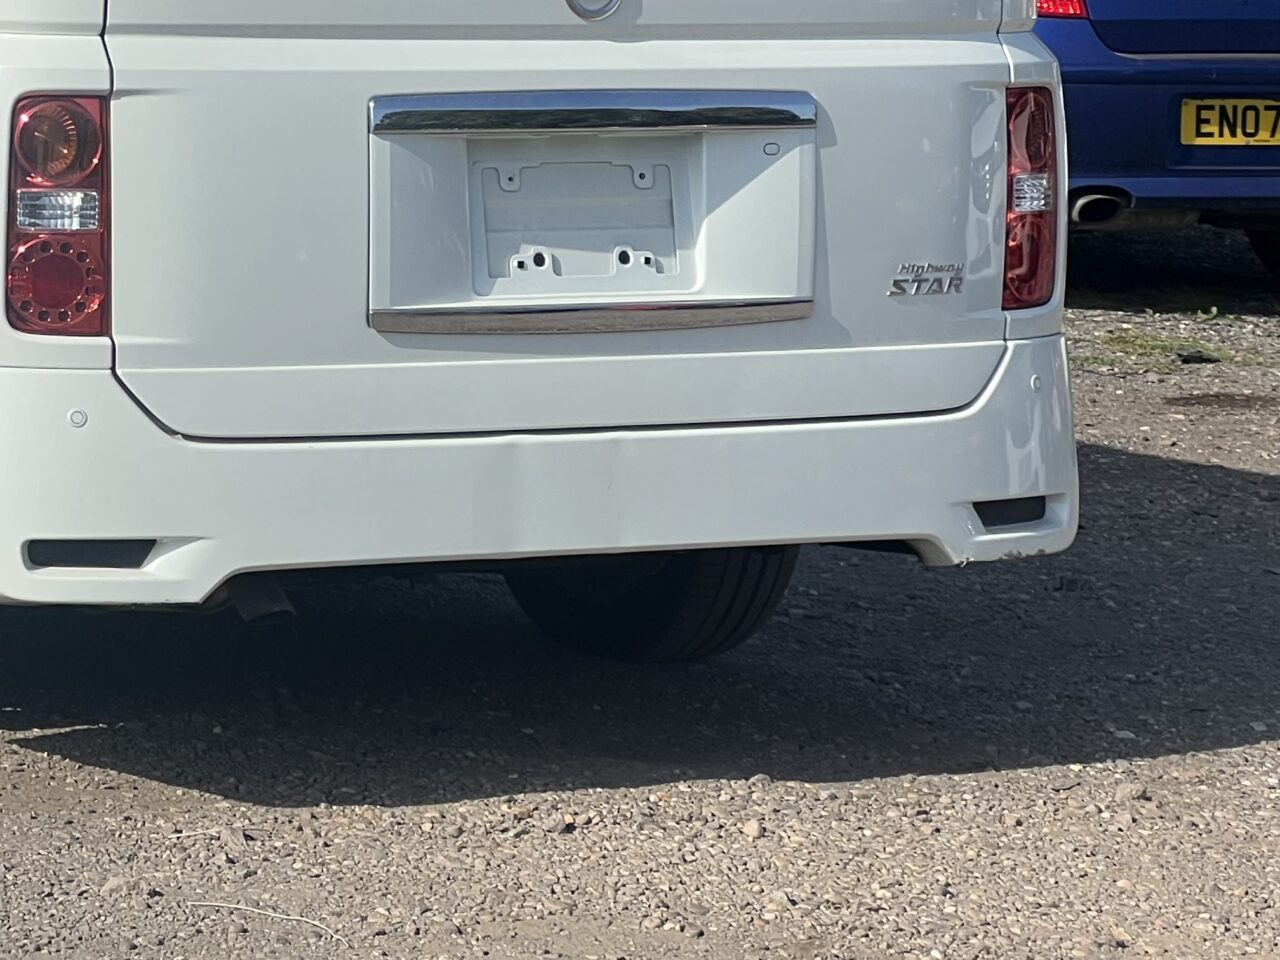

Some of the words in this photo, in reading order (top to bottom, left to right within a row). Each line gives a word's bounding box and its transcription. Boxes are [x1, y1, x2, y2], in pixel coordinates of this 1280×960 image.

[1195, 104, 1280, 138] EN07
[897, 262, 964, 278] Highway
[886, 276, 963, 296] STAR
